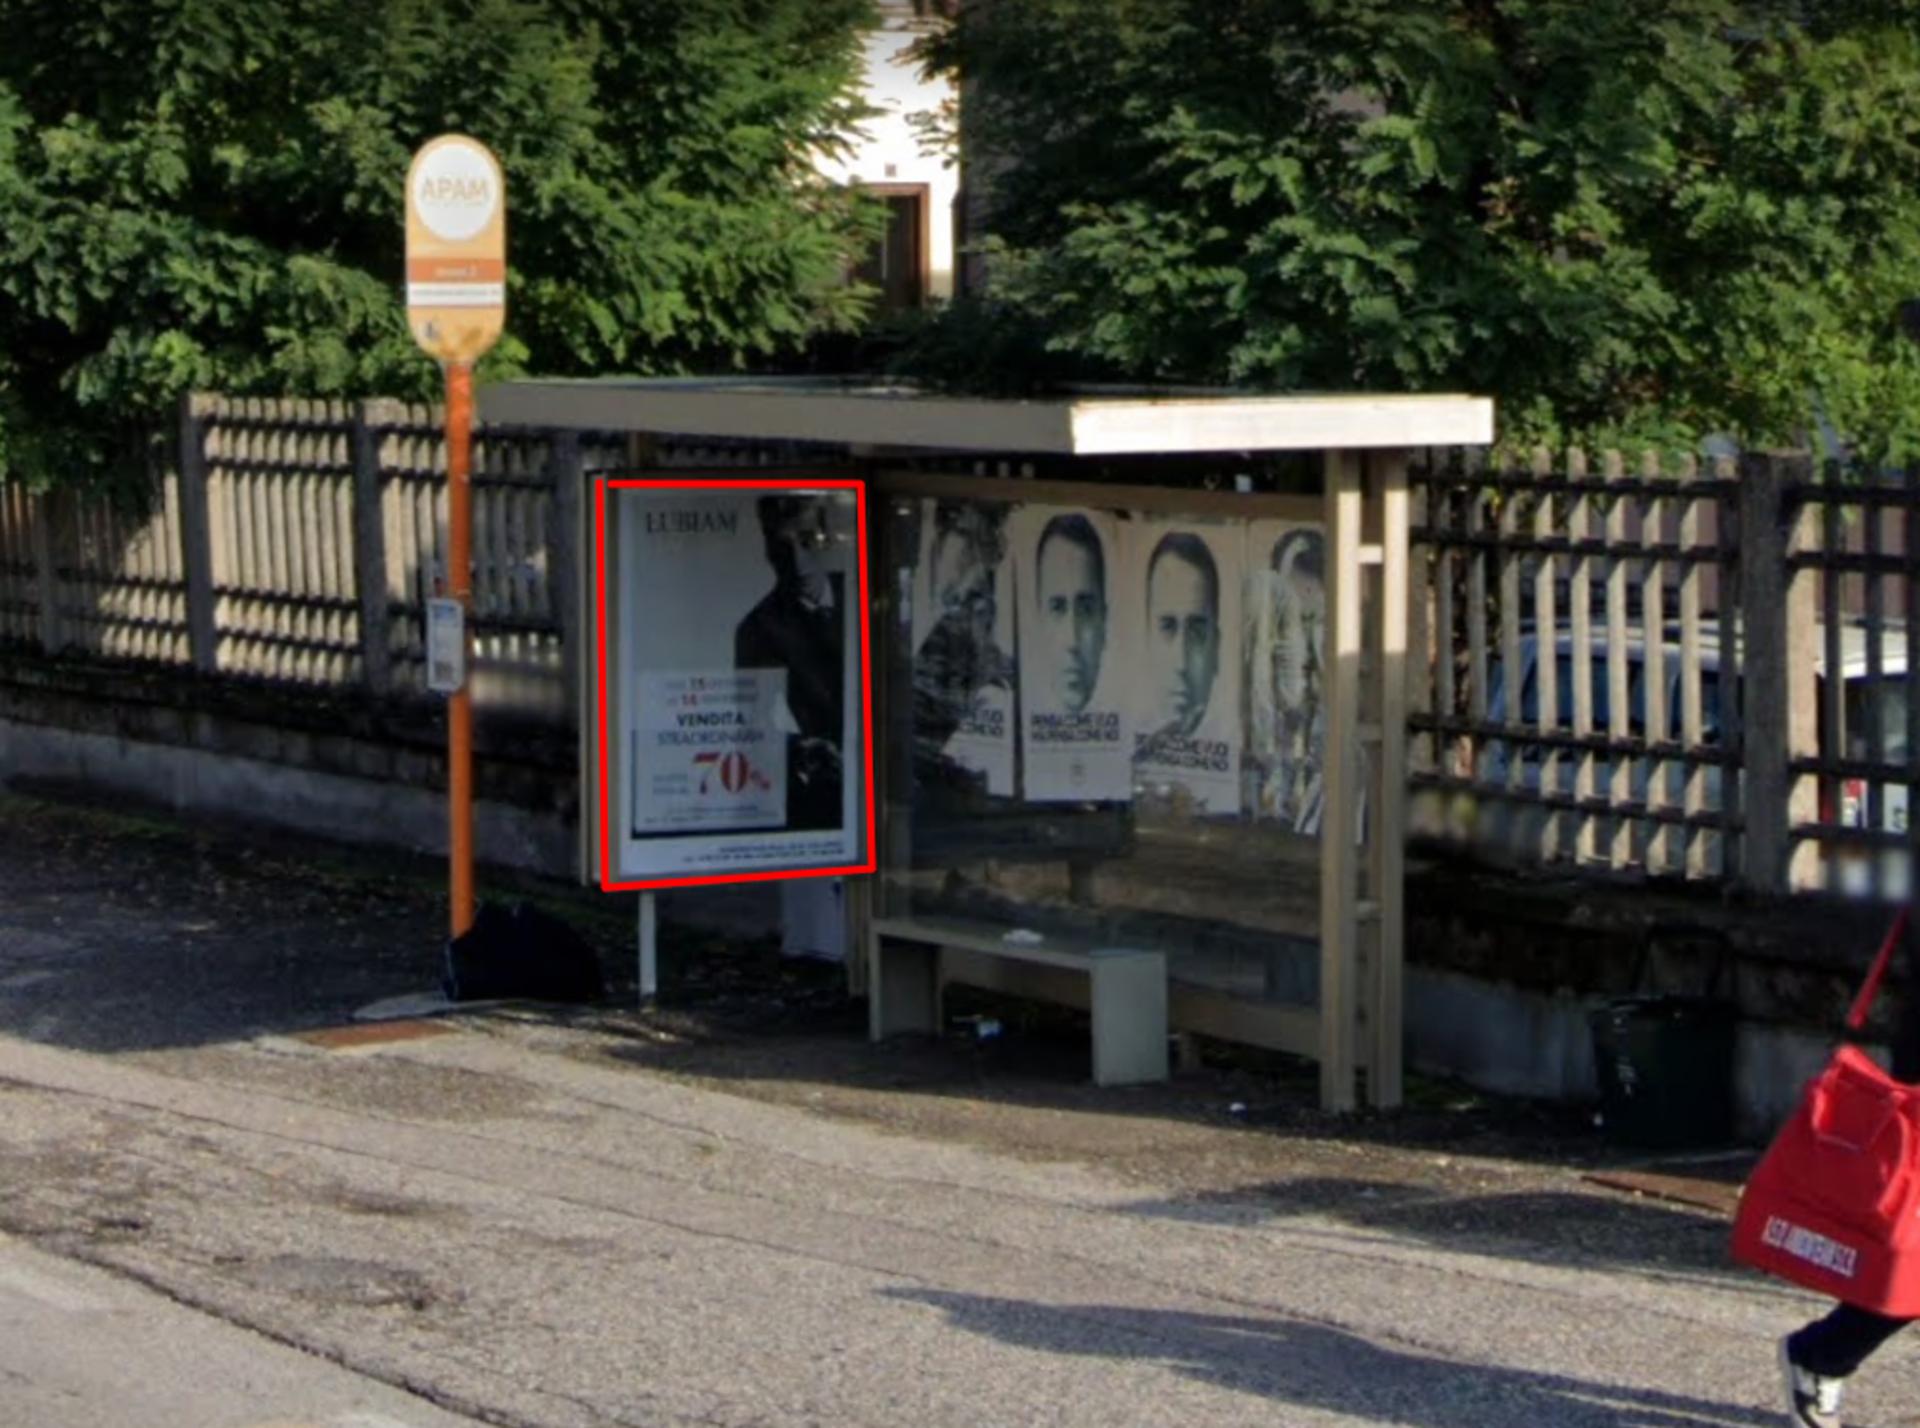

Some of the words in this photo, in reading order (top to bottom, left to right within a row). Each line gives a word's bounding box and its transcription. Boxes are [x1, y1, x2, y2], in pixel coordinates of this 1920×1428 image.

[421, 176, 490, 200] APAM
[646, 510, 738, 534] LUBIAM
[677, 711, 745, 726] VENDITA
